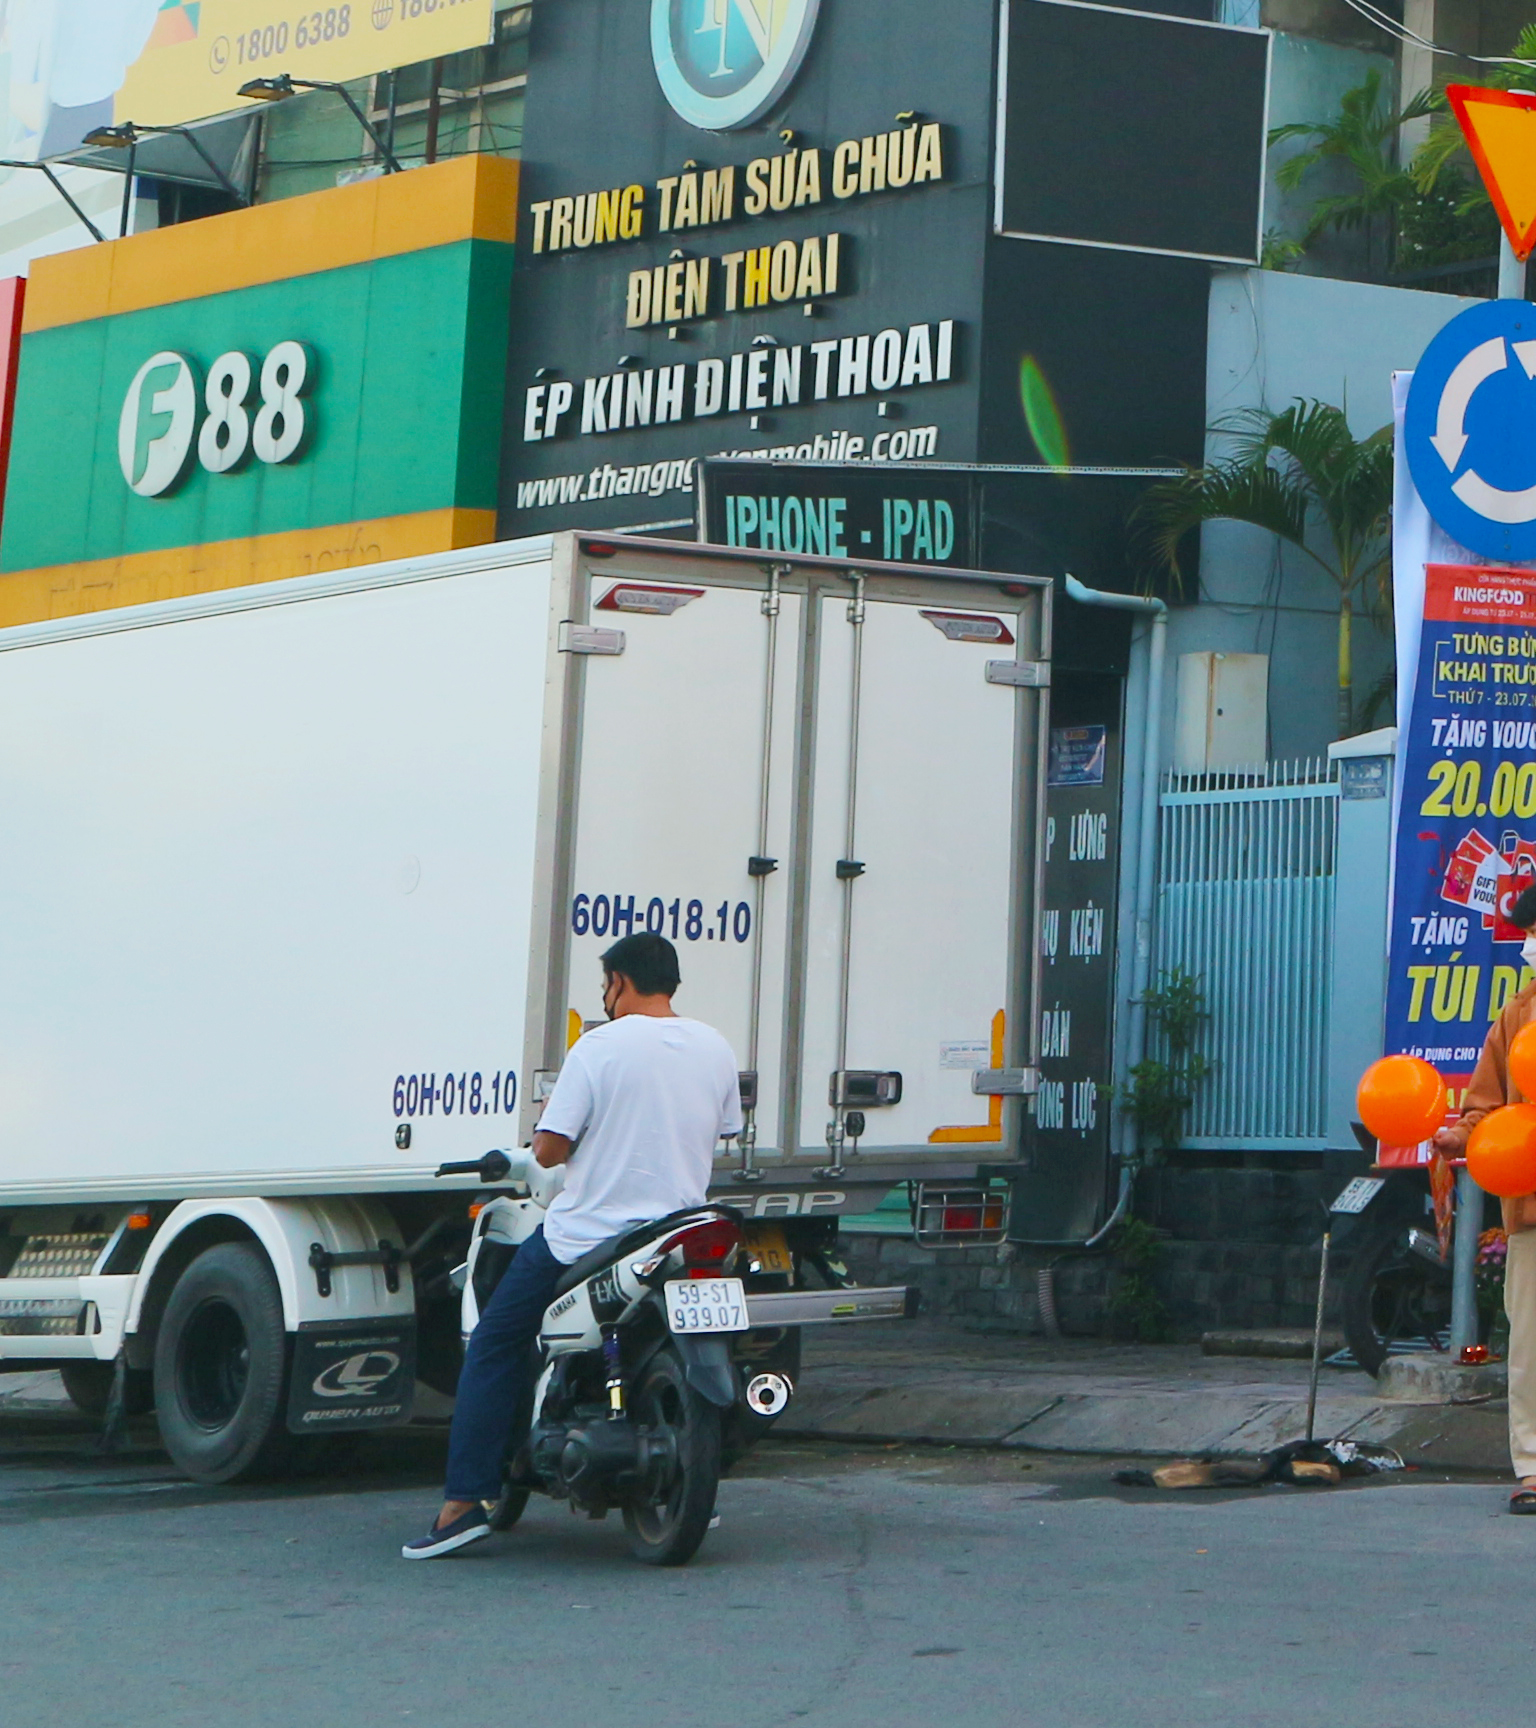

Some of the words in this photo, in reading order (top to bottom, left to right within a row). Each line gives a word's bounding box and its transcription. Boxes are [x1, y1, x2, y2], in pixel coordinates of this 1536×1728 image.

[235, 21, 289, 65] 1800
[295, 3, 352, 51] 6388
[530, 183, 644, 254] TRUNG
[656, 159, 734, 232] TÂM
[744, 129, 821, 216] SỬA
[832, 111, 943, 200] CHỮA
[625, 249, 709, 339] ĐIỆN
[721, 233, 840, 316] THOẠI
[523, 368, 573, 442] ÉP
[581, 355, 686, 435] KÍNH
[694, 334, 802, 430] ĐIỆN
[810, 319, 954, 417] THOẠI
[118, 341, 309, 497] F88
[726, 495, 848, 557] IPHONE
[883, 498, 955, 560] IPAD
[1452, 631, 1503, 657] TƯNG
[1438, 660, 1487, 683] KHAI
[1448, 687, 1476, 705] THỨ
[1476, 691, 1484, 705] 7
[1431, 713, 1487, 756] TẶNG
[1069, 808, 1107, 862] LƯNG
[1475, 875, 1498, 890] GIFT
[572, 892, 752, 944] 60H-018.10
[1041, 909, 1060, 966] HỤ
[1069, 898, 1104, 965] KIỆN
[1409, 911, 1470, 955] TẶNG
[1406, 951, 1481, 1023] TÚI
[1041, 1000, 1071, 1058] DÁN
[1424, 1047, 1453, 1066] DỤNG
[1453, 1046, 1476, 1062] CHO
[392, 1070, 518, 1118] 60H-018.10
[1071, 1076, 1097, 1139] LỰC
[548, 1293, 578, 1321] YAMAHA
[674, 1305, 741, 1329] 939.07
[678, 1283, 731, 1305] 59-S1
